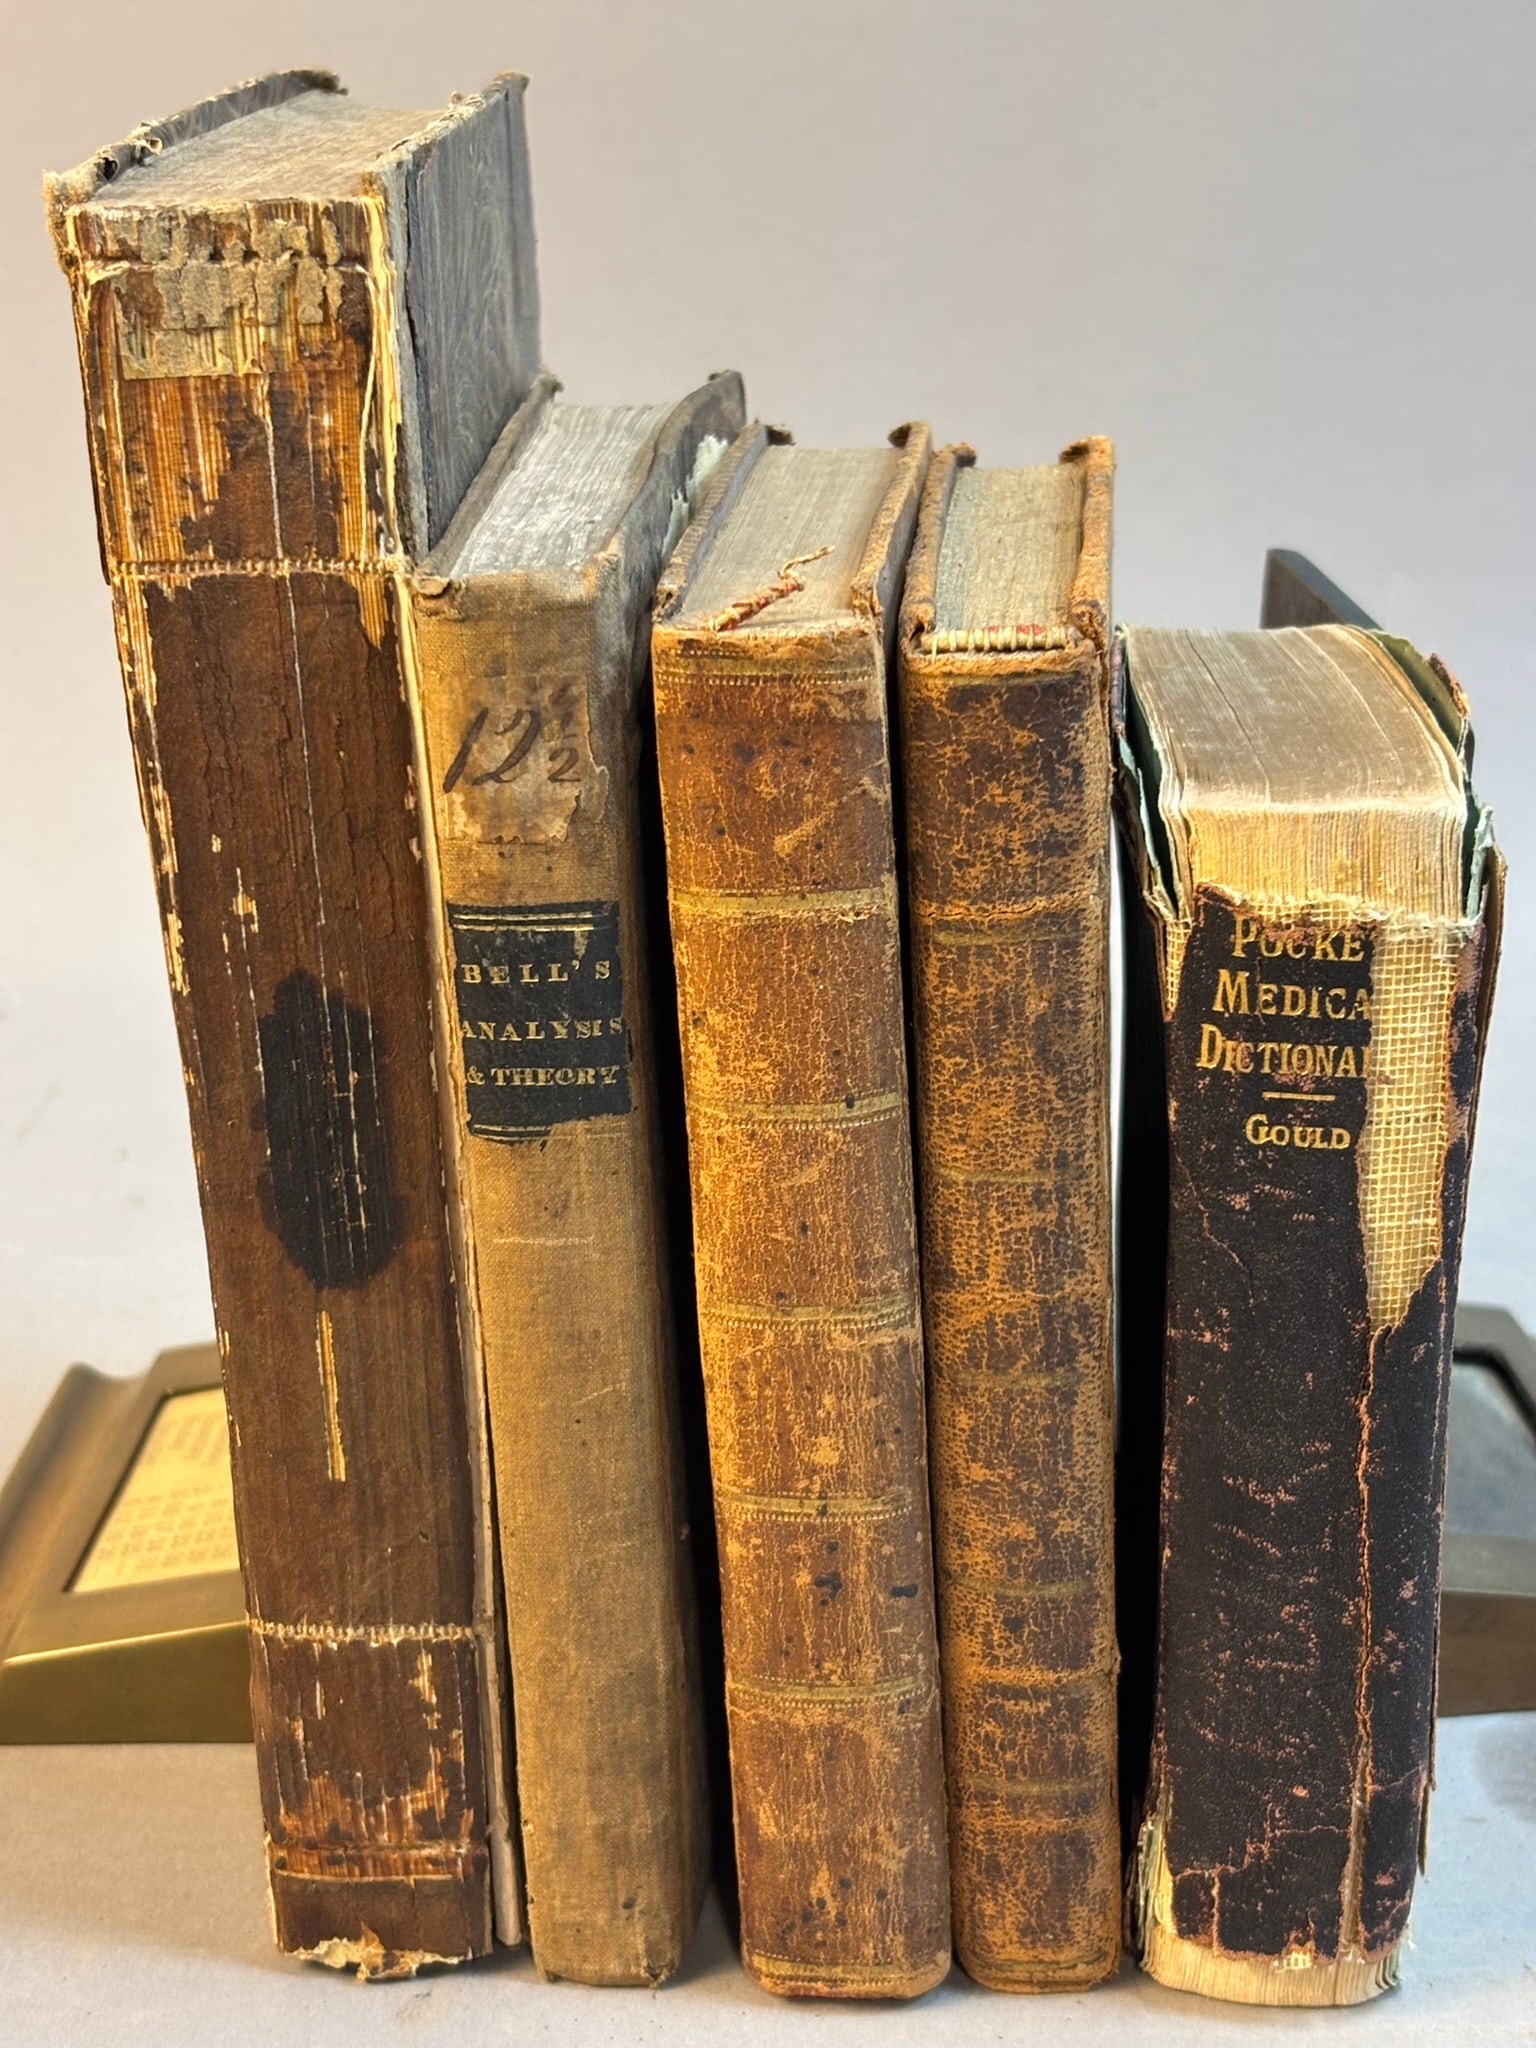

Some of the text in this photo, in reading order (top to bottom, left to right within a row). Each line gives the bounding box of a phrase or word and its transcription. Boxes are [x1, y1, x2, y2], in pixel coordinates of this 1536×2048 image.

[1231, 912, 1366, 962] POCKE
[461, 959, 611, 984] BELL'S
[460, 1016, 624, 1042] ANALYSIS
[466, 1064, 620, 1087] & THEORY
[1244, 1113, 1351, 1150] GOULD
